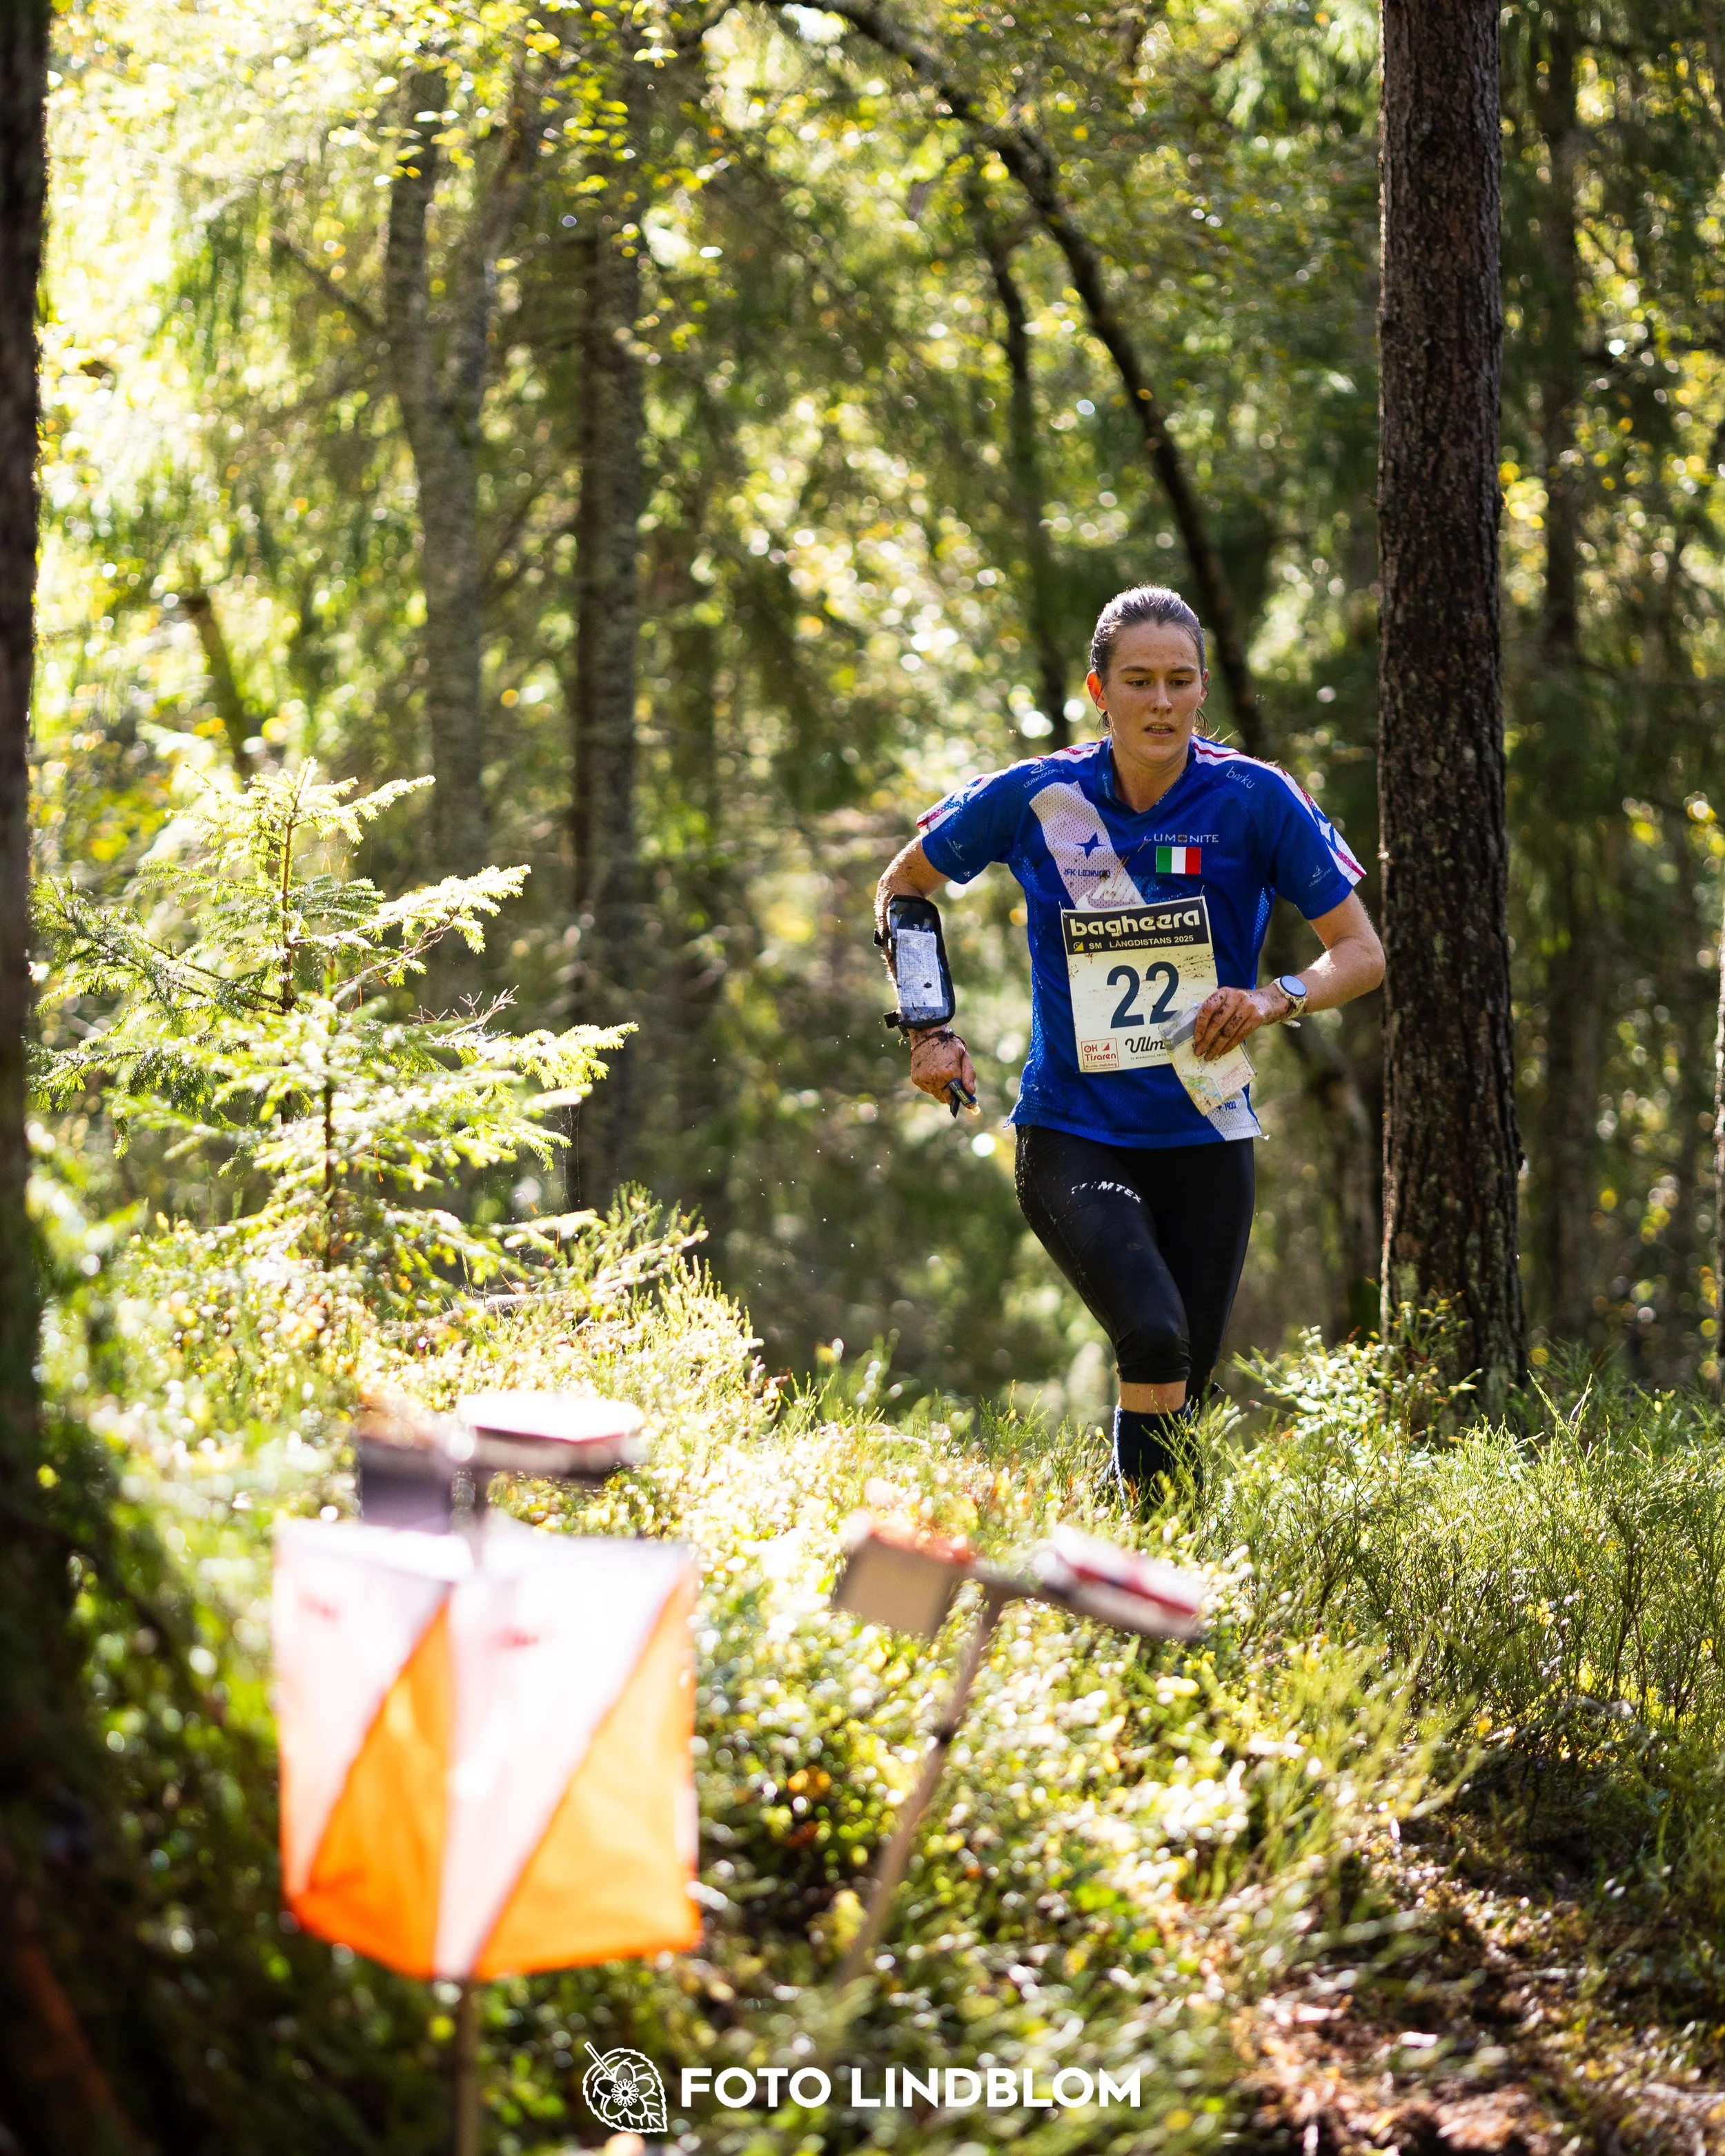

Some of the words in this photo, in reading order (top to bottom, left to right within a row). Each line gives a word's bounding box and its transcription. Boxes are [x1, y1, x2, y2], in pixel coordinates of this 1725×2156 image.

[1070, 909, 1201, 937] bagheera
[1088, 942, 1103, 950] SM
[1174, 935, 1194, 943] 2025
[1107, 961, 1179, 1029] 22
[1085, 1053, 1116, 1061] Tisaren
